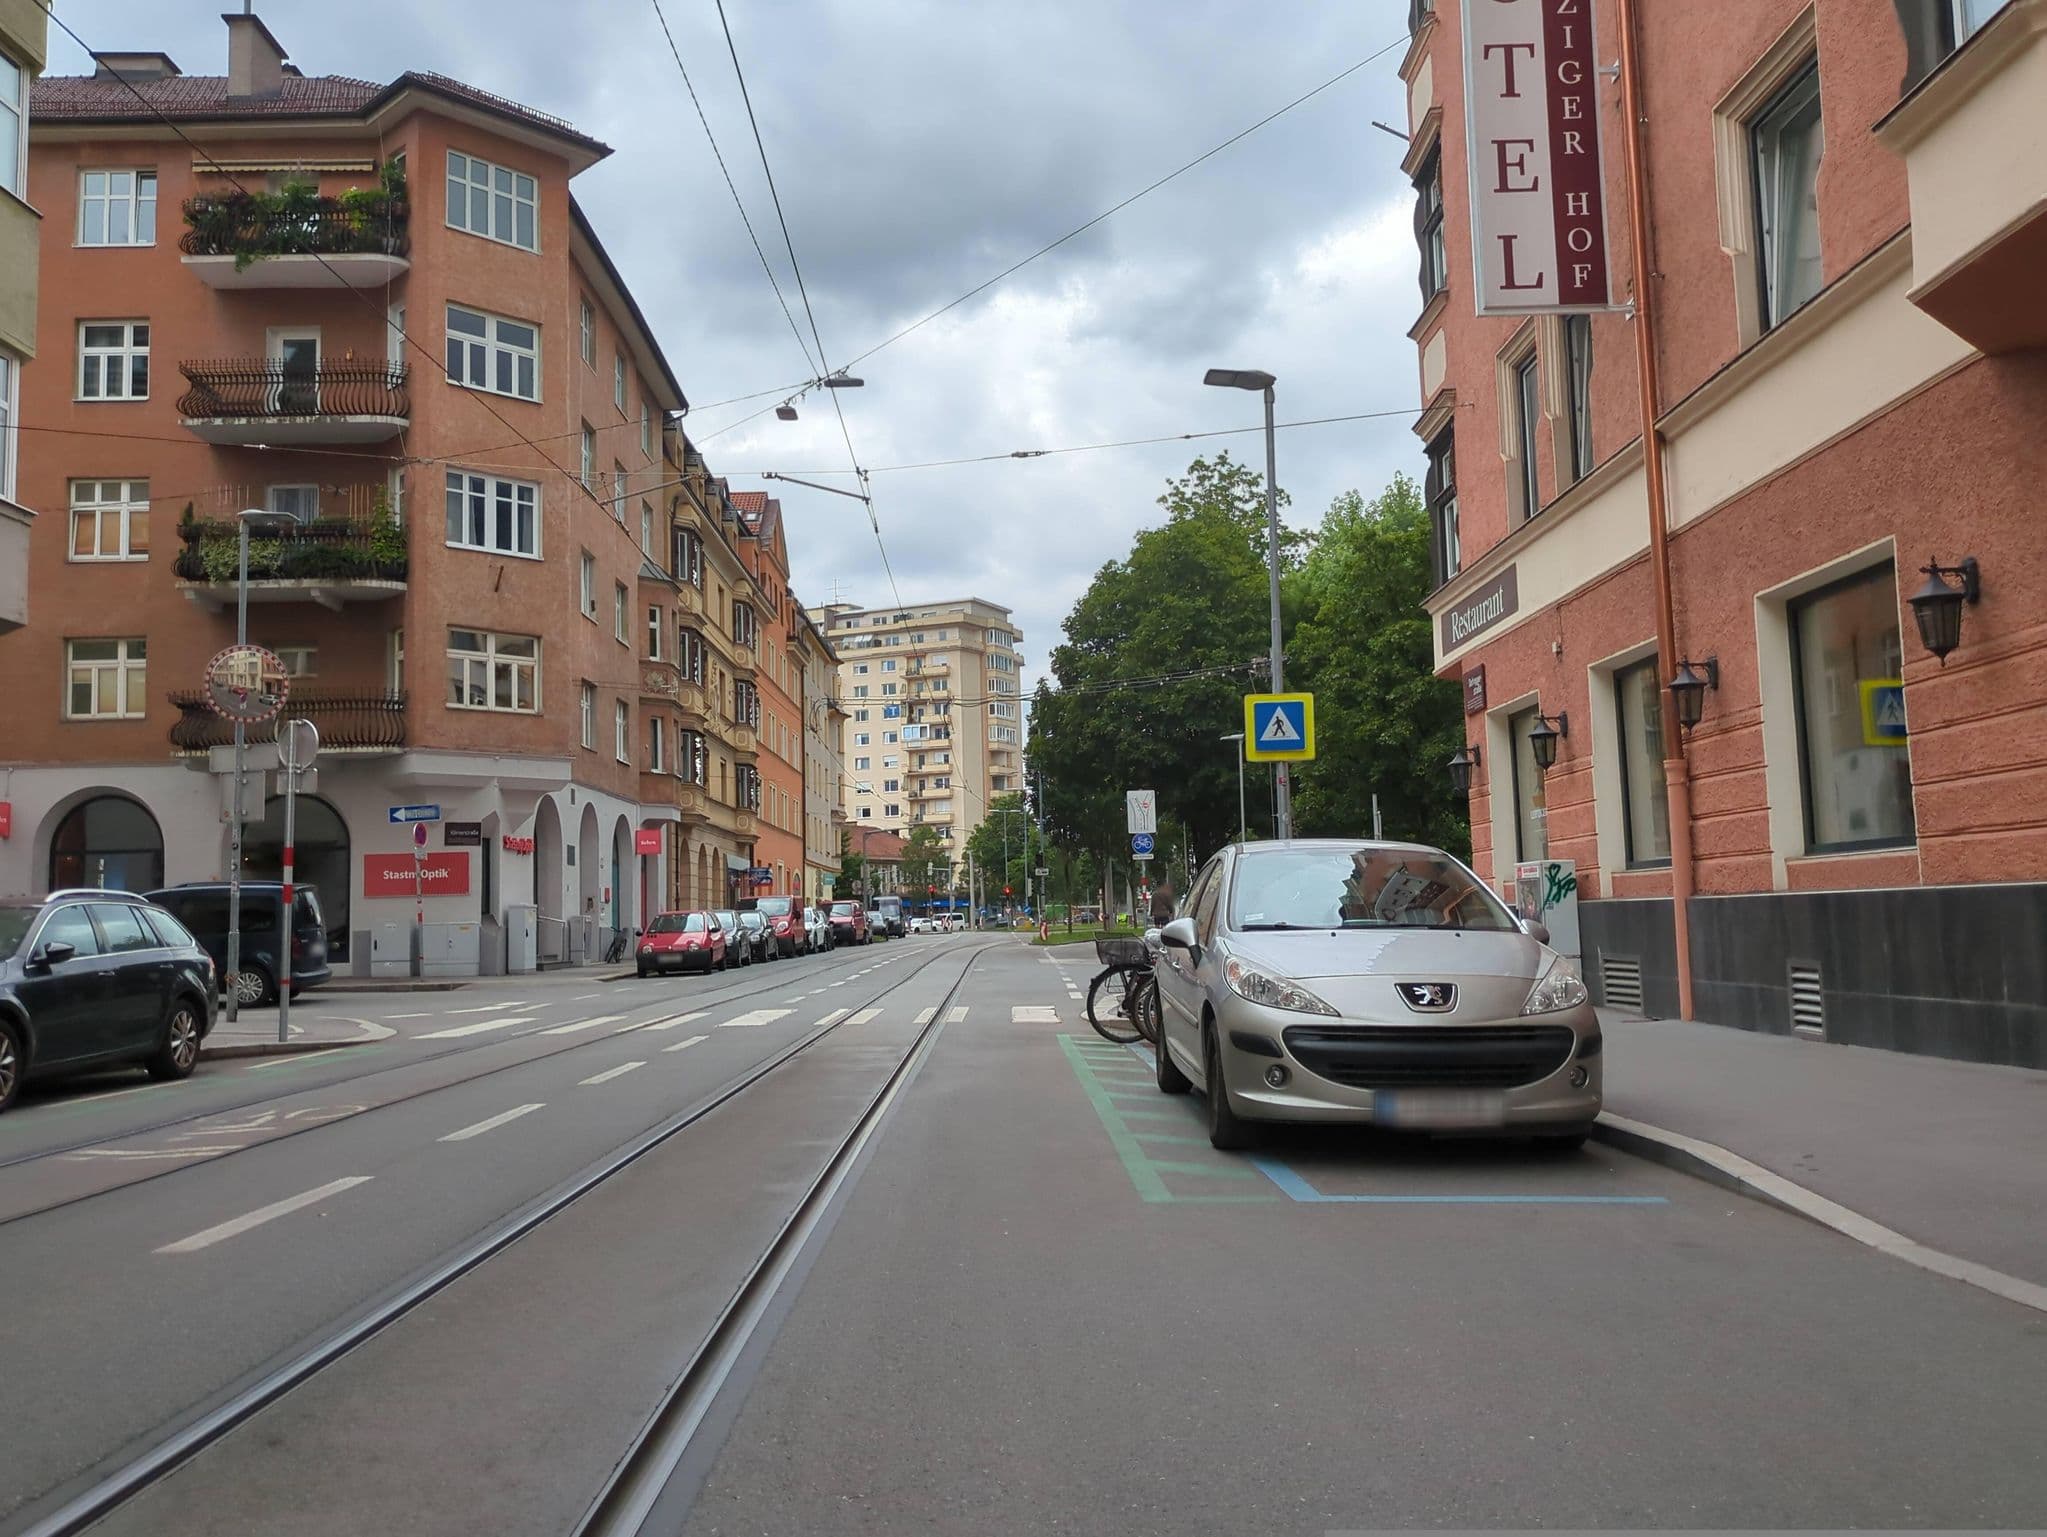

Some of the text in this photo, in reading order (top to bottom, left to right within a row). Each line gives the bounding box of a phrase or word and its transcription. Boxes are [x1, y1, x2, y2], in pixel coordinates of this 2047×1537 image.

[1483, 0, 1544, 290] TEL
[1565, 192, 1592, 288] HOF
[1451, 584, 1504, 643] Restaurant
[383, 868, 449, 880] Stastn Optik
